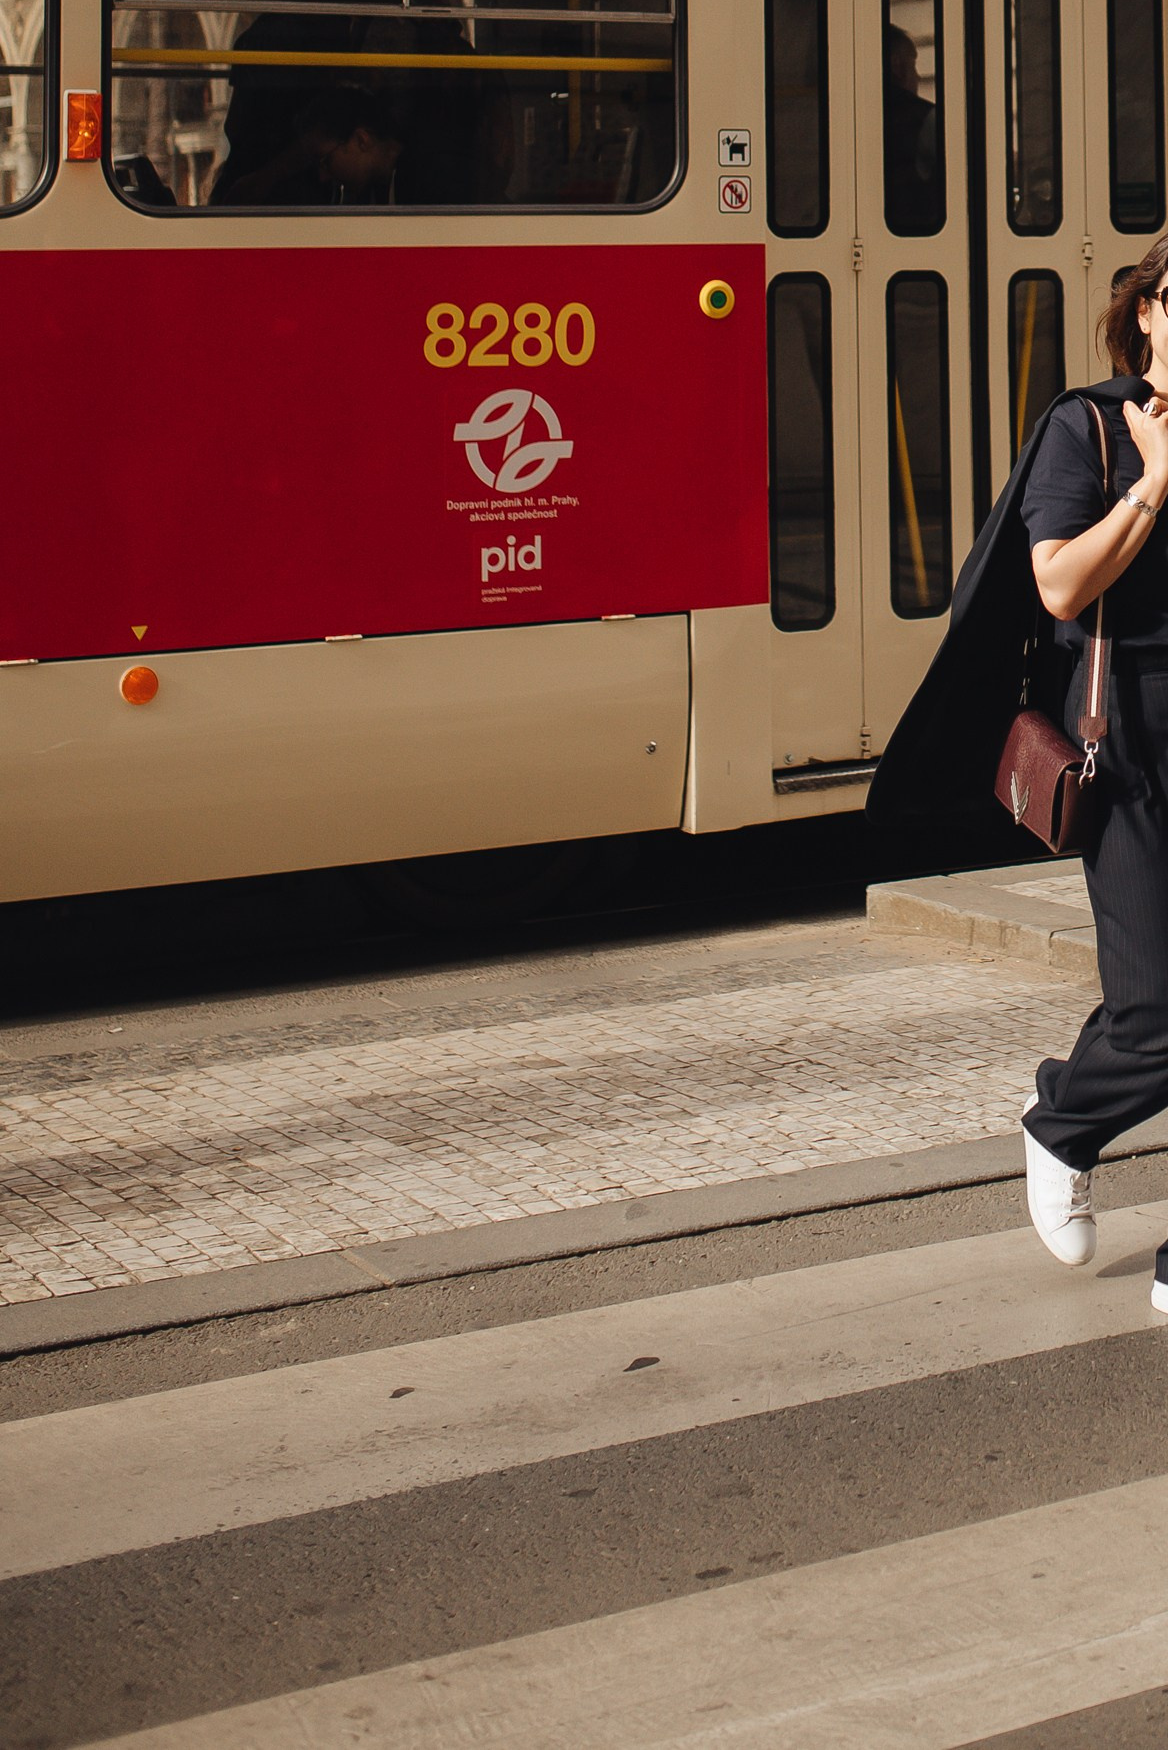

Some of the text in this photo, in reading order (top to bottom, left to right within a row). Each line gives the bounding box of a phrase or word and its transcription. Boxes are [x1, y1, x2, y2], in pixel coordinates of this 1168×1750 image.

[423, 302, 596, 368] 8280
[446, 499, 489, 512] Dopravní
[490, 497, 522, 510] podnik
[524, 496, 535, 507] hl.
[538, 497, 549, 506] m.
[469, 509, 558, 522] akciová společnost
[481, 535, 542, 582] pid
